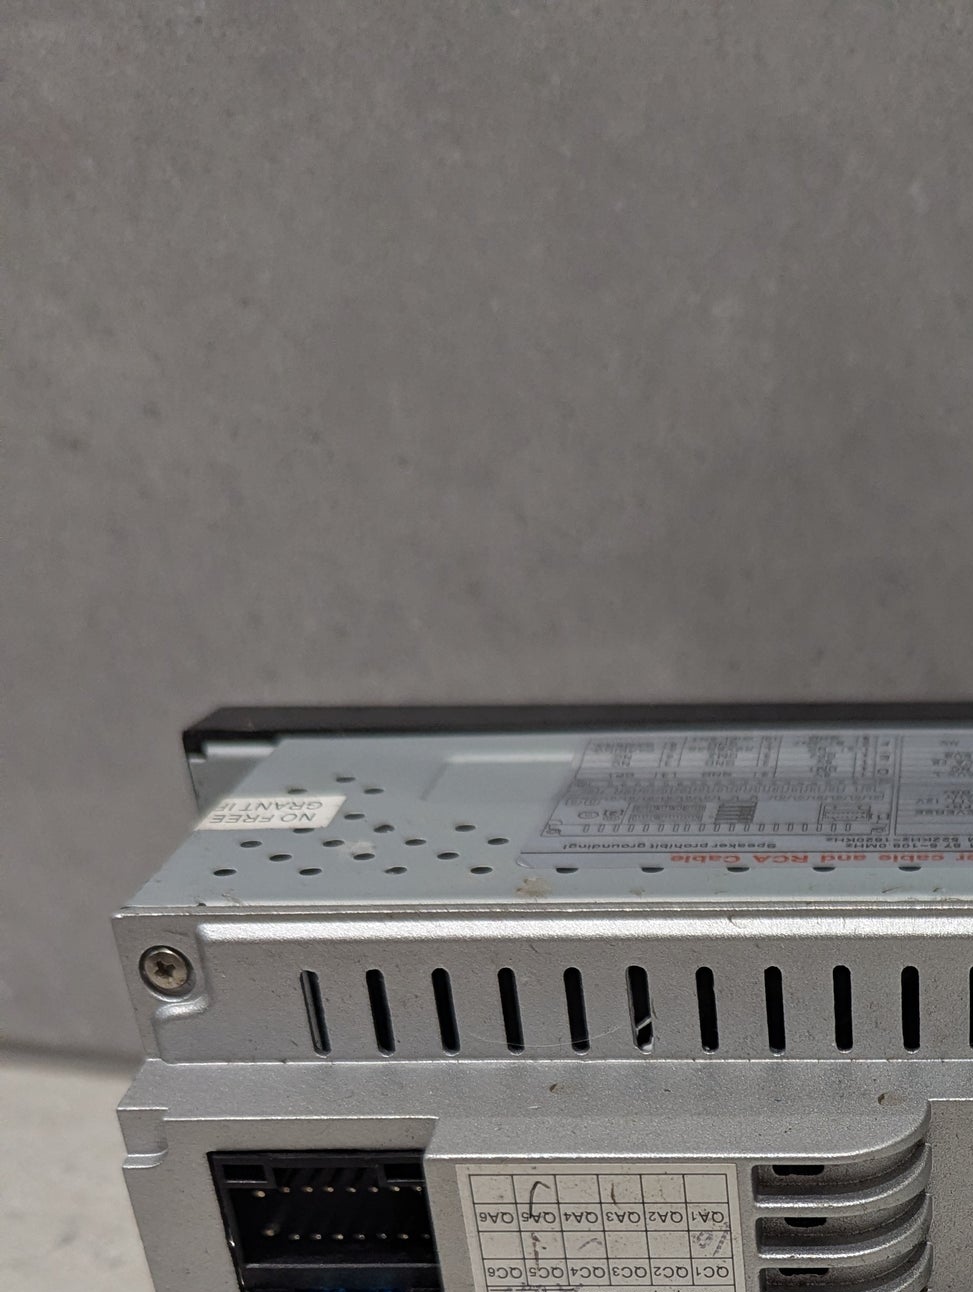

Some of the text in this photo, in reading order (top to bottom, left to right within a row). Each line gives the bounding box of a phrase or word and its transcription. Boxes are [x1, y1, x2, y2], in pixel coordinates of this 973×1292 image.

[238, 801, 324, 812] GRANT
[208, 813, 317, 824] NO FREE
[649, 842, 709, 850] prohibit
[670, 854, 741, 864] Cable
[752, 854, 809, 864] RCA
[820, 854, 867, 863] and
[877, 853, 944, 863] cable
[478, 1211, 515, 1224] QA6
[521, 1211, 557, 1224] QA5
[563, 1211, 599, 1224] QA4
[605, 1211, 642, 1224] QA3
[648, 1211, 684, 1224] QA2
[690, 1210, 725, 1224] QA1
[487, 1266, 523, 1280] QC6
[528, 1266, 565, 1279] QC5
[569, 1266, 606, 1279] QC4
[611, 1266, 648, 1279] QC3
[652, 1266, 689, 1279] QC2
[695, 1265, 730, 1279] QC1
